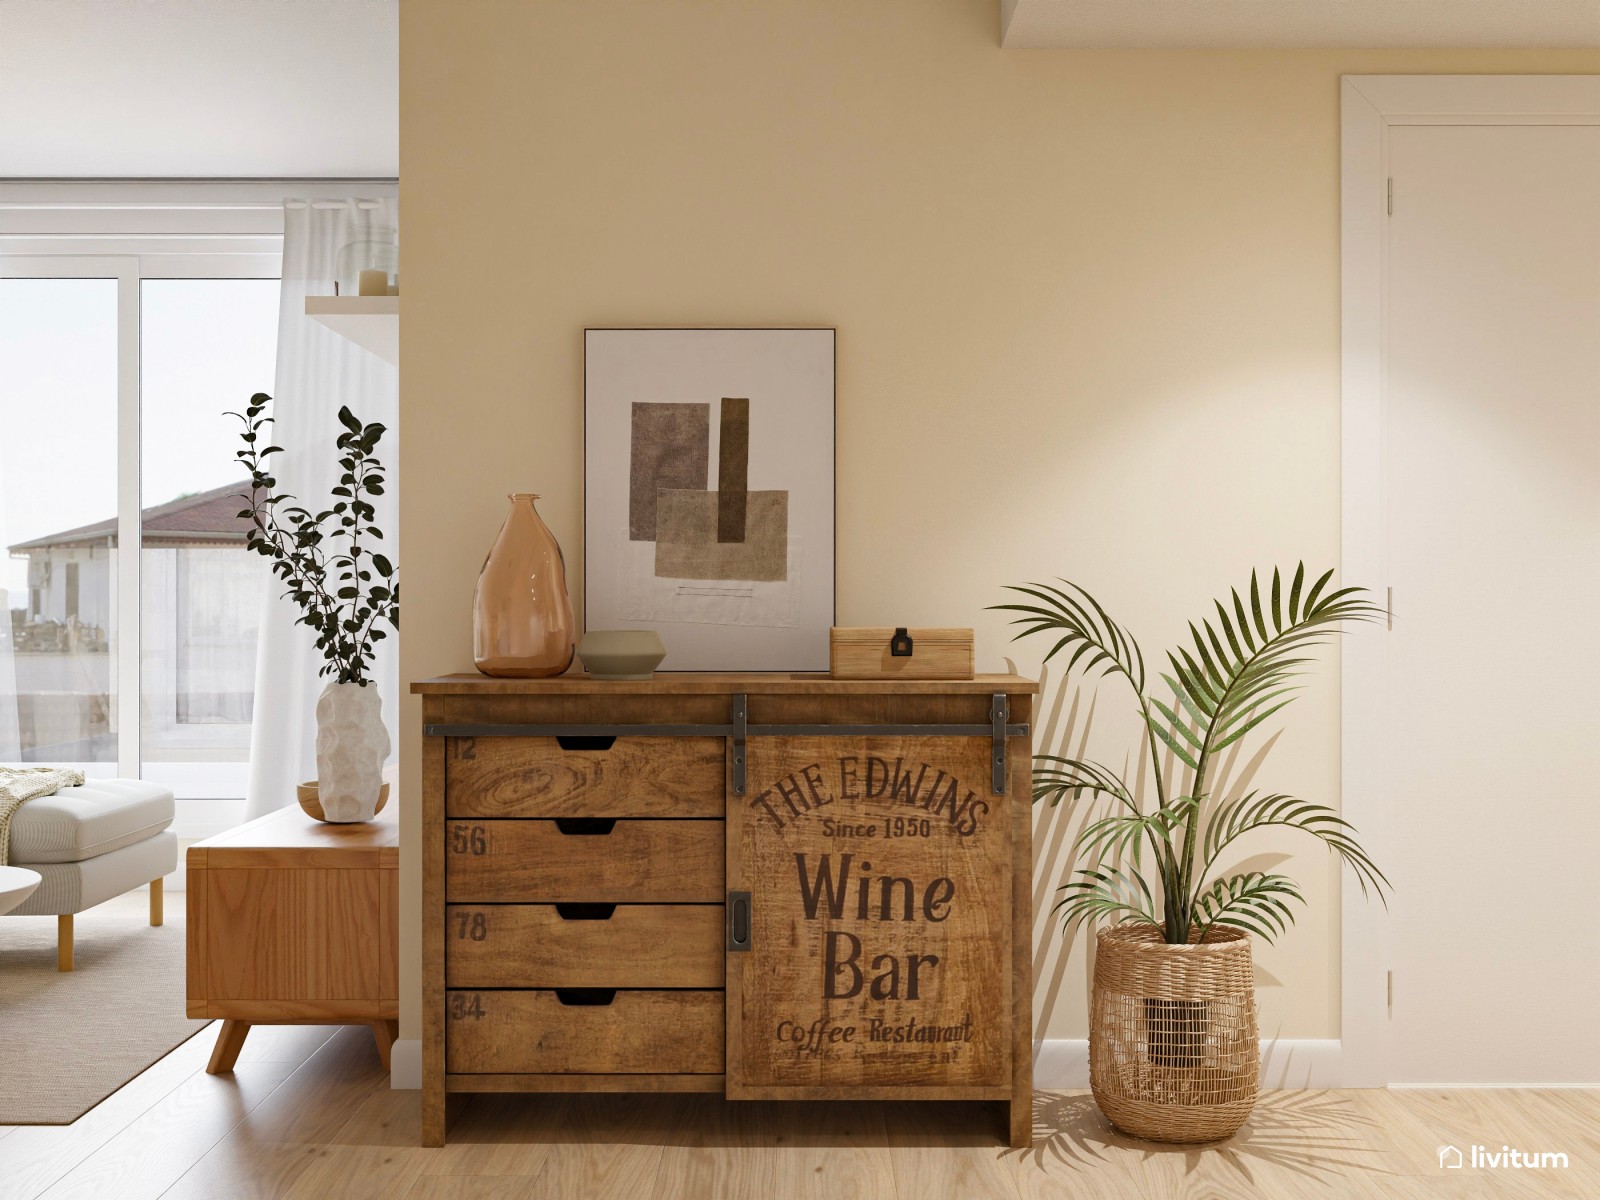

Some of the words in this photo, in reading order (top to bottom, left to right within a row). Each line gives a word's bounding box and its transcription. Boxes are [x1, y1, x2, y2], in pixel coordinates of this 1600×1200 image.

[751, 763, 833, 829] THE
[838, 756, 989, 837] EDWINS
[453, 825, 486, 856] 56
[822, 818, 876, 838] Since
[883, 818, 931, 839] 1950
[793, 852, 955, 923] Wine
[456, 911, 487, 941] 78
[822, 931, 939, 1001] Bar
[777, 1019, 856, 1051] Coffee
[869, 1013, 973, 1043] Restaurant
